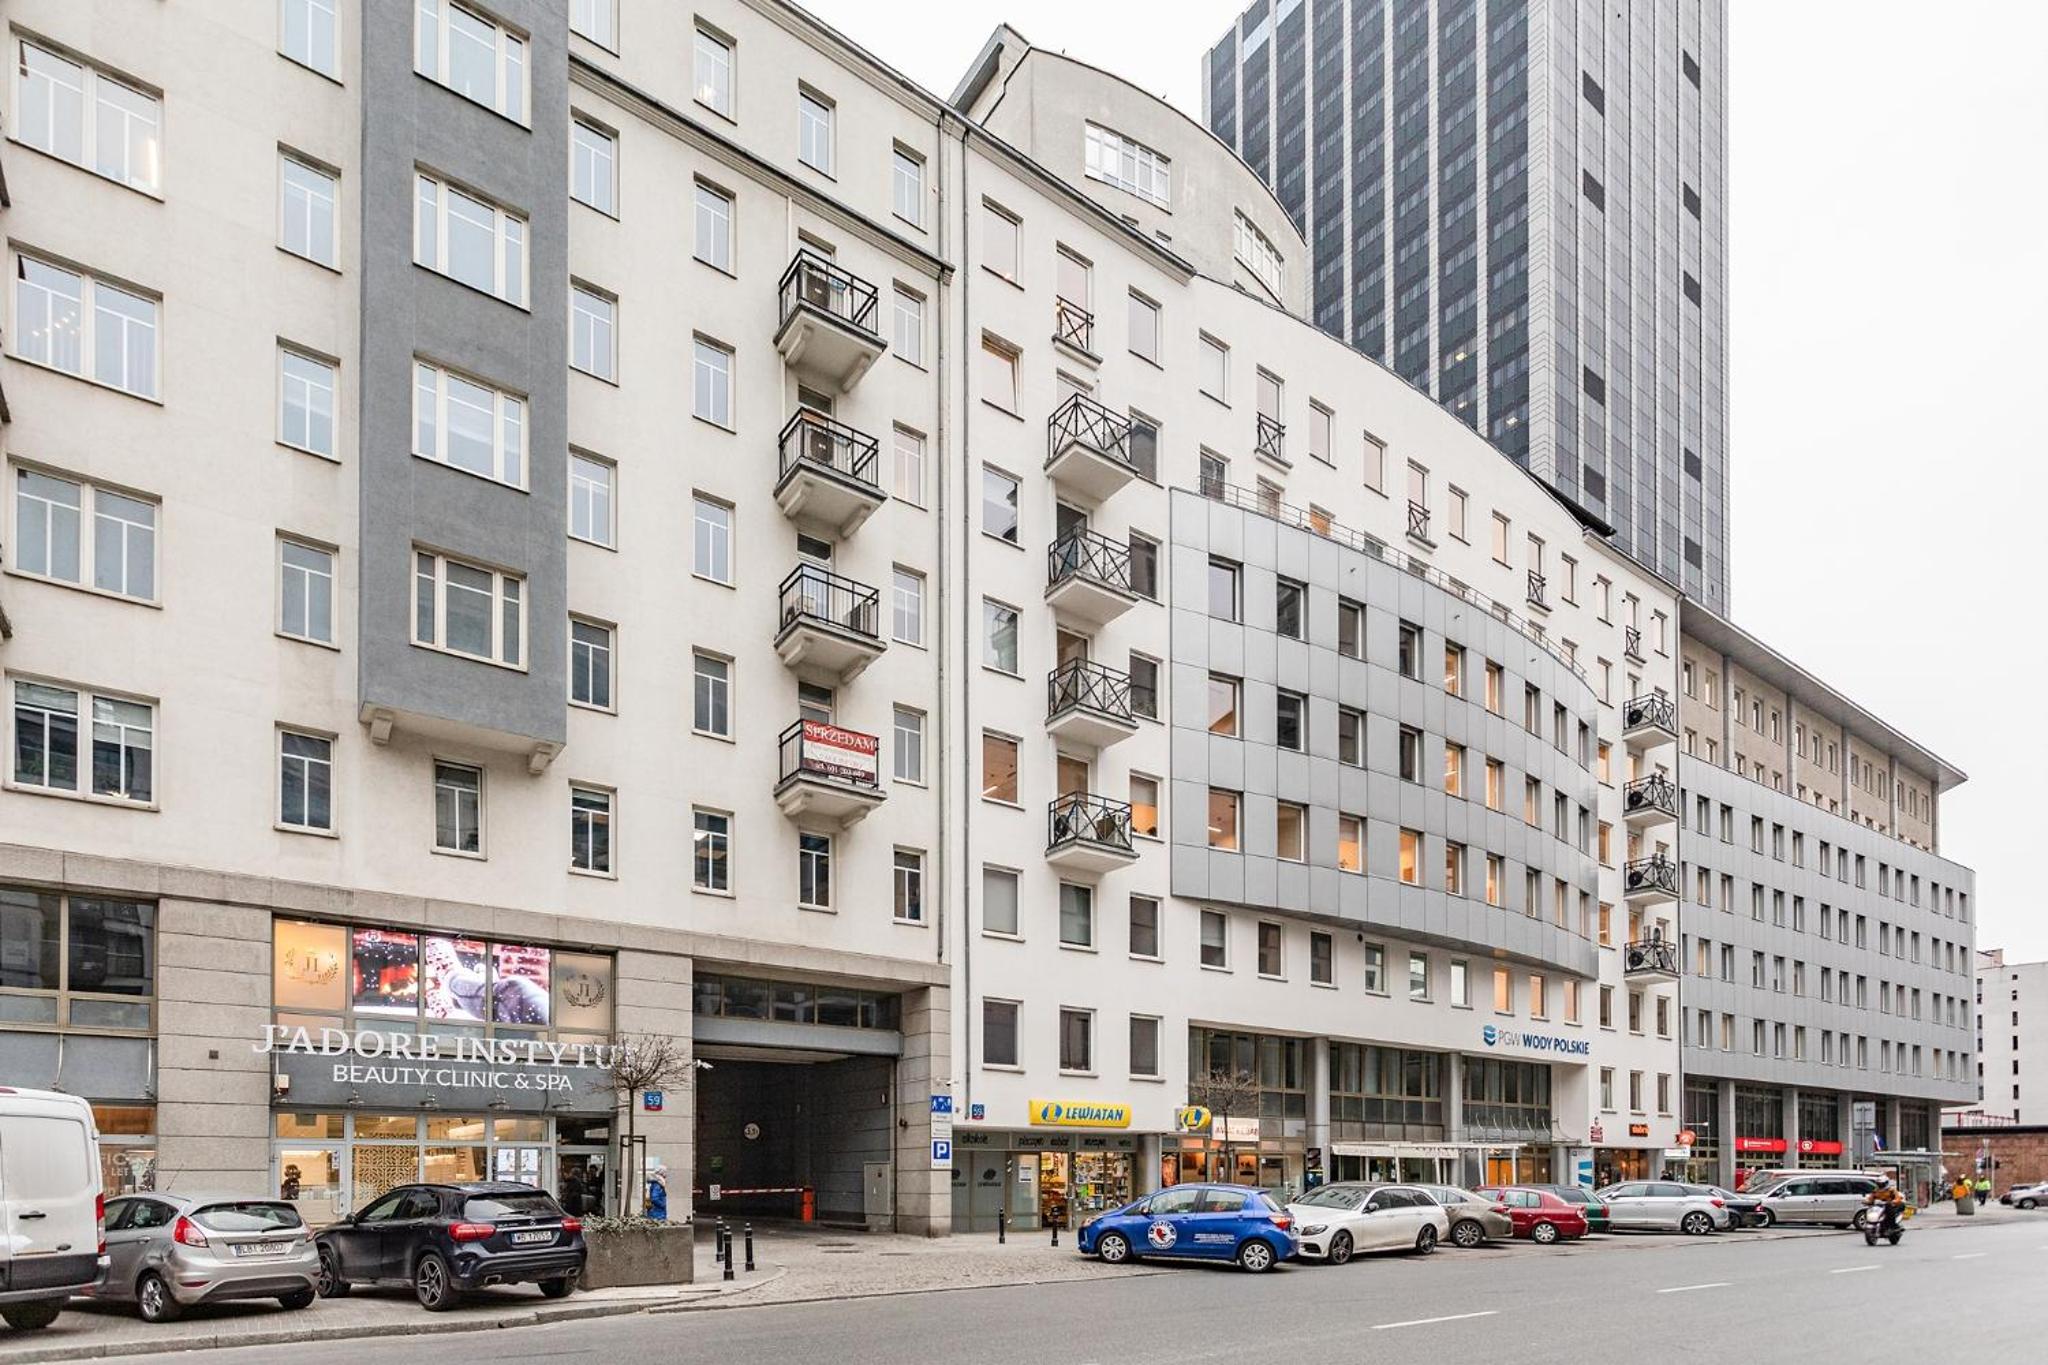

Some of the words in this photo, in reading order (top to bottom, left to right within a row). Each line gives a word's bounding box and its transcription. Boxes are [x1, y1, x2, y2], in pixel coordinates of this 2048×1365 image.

[805, 724, 875, 751] SPRZEDAM
[252, 1024, 441, 1061] J'ADORE
[1499, 1030, 1520, 1047] PGW
[1522, 1034, 1552, 1050] WODY
[1553, 1039, 1590, 1055] POLSKIE
[333, 1065, 430, 1086] BEAUTY
[436, 1069, 509, 1089] CLINIC
[514, 1073, 530, 1090] &
[535, 1074, 573, 1091] SPA
[647, 1095, 660, 1106] 59
[1065, 1107, 1124, 1121] LEWIATAN
[937, 1143, 947, 1158] P
